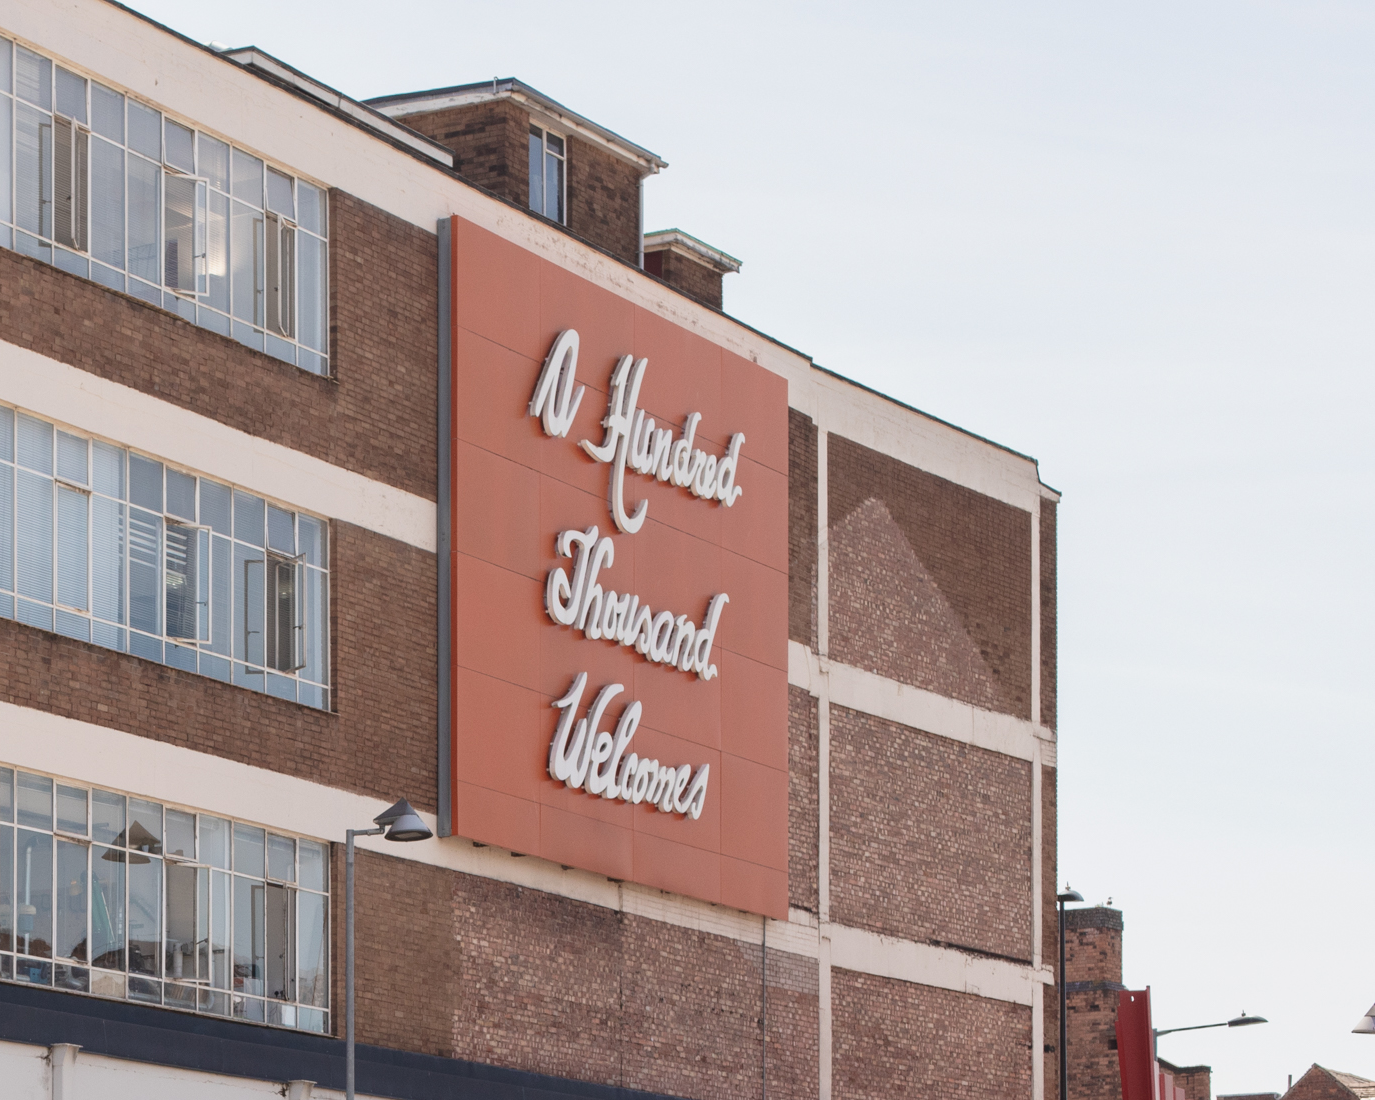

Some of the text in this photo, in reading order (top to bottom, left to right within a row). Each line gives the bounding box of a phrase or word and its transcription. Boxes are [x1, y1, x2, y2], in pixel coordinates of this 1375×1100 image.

[578, 353, 746, 534] Hundred
[544, 524, 730, 682] Thousand
[547, 671, 711, 820] Welcomes
